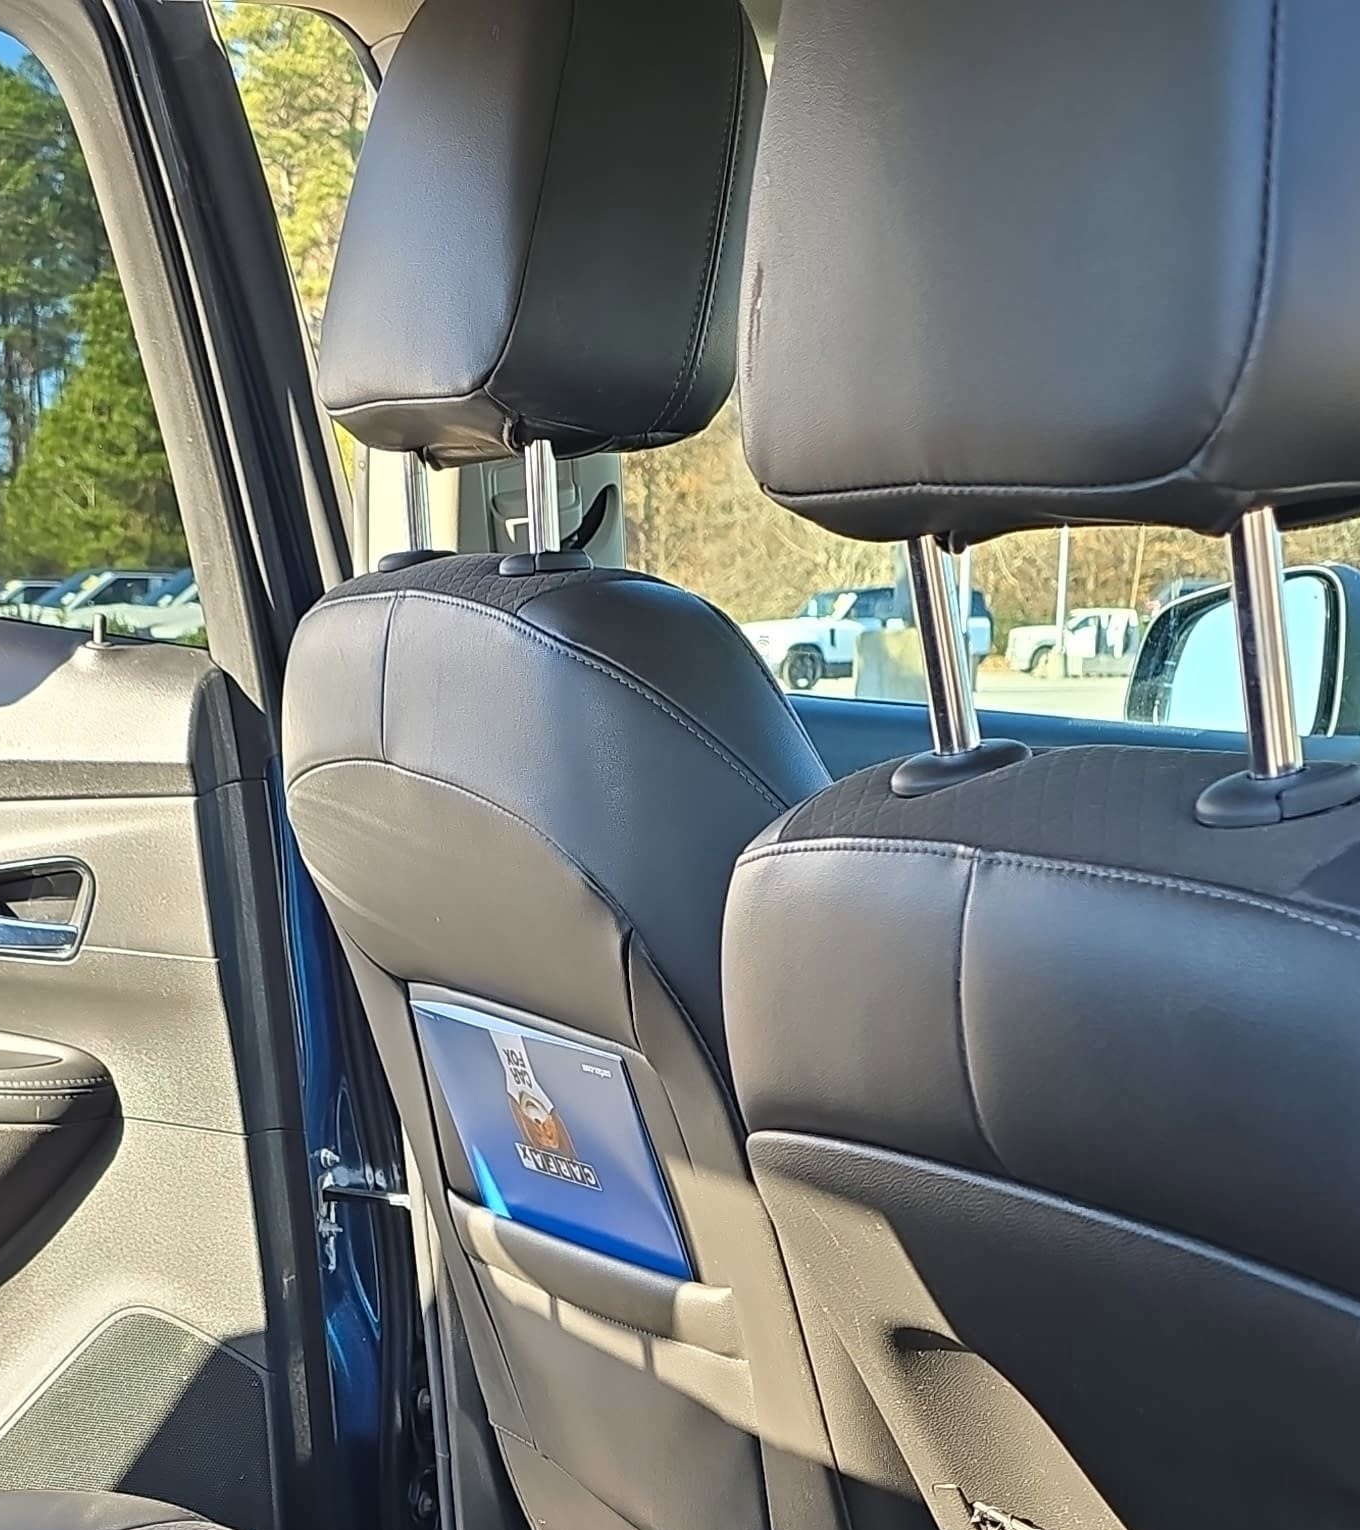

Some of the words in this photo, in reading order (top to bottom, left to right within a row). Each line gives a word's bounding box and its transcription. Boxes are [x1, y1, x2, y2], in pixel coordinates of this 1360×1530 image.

[502, 1048, 525, 1068] FOX
[513, 1067, 534, 1088] CAR
[519, 1145, 598, 1186] CARFAX
